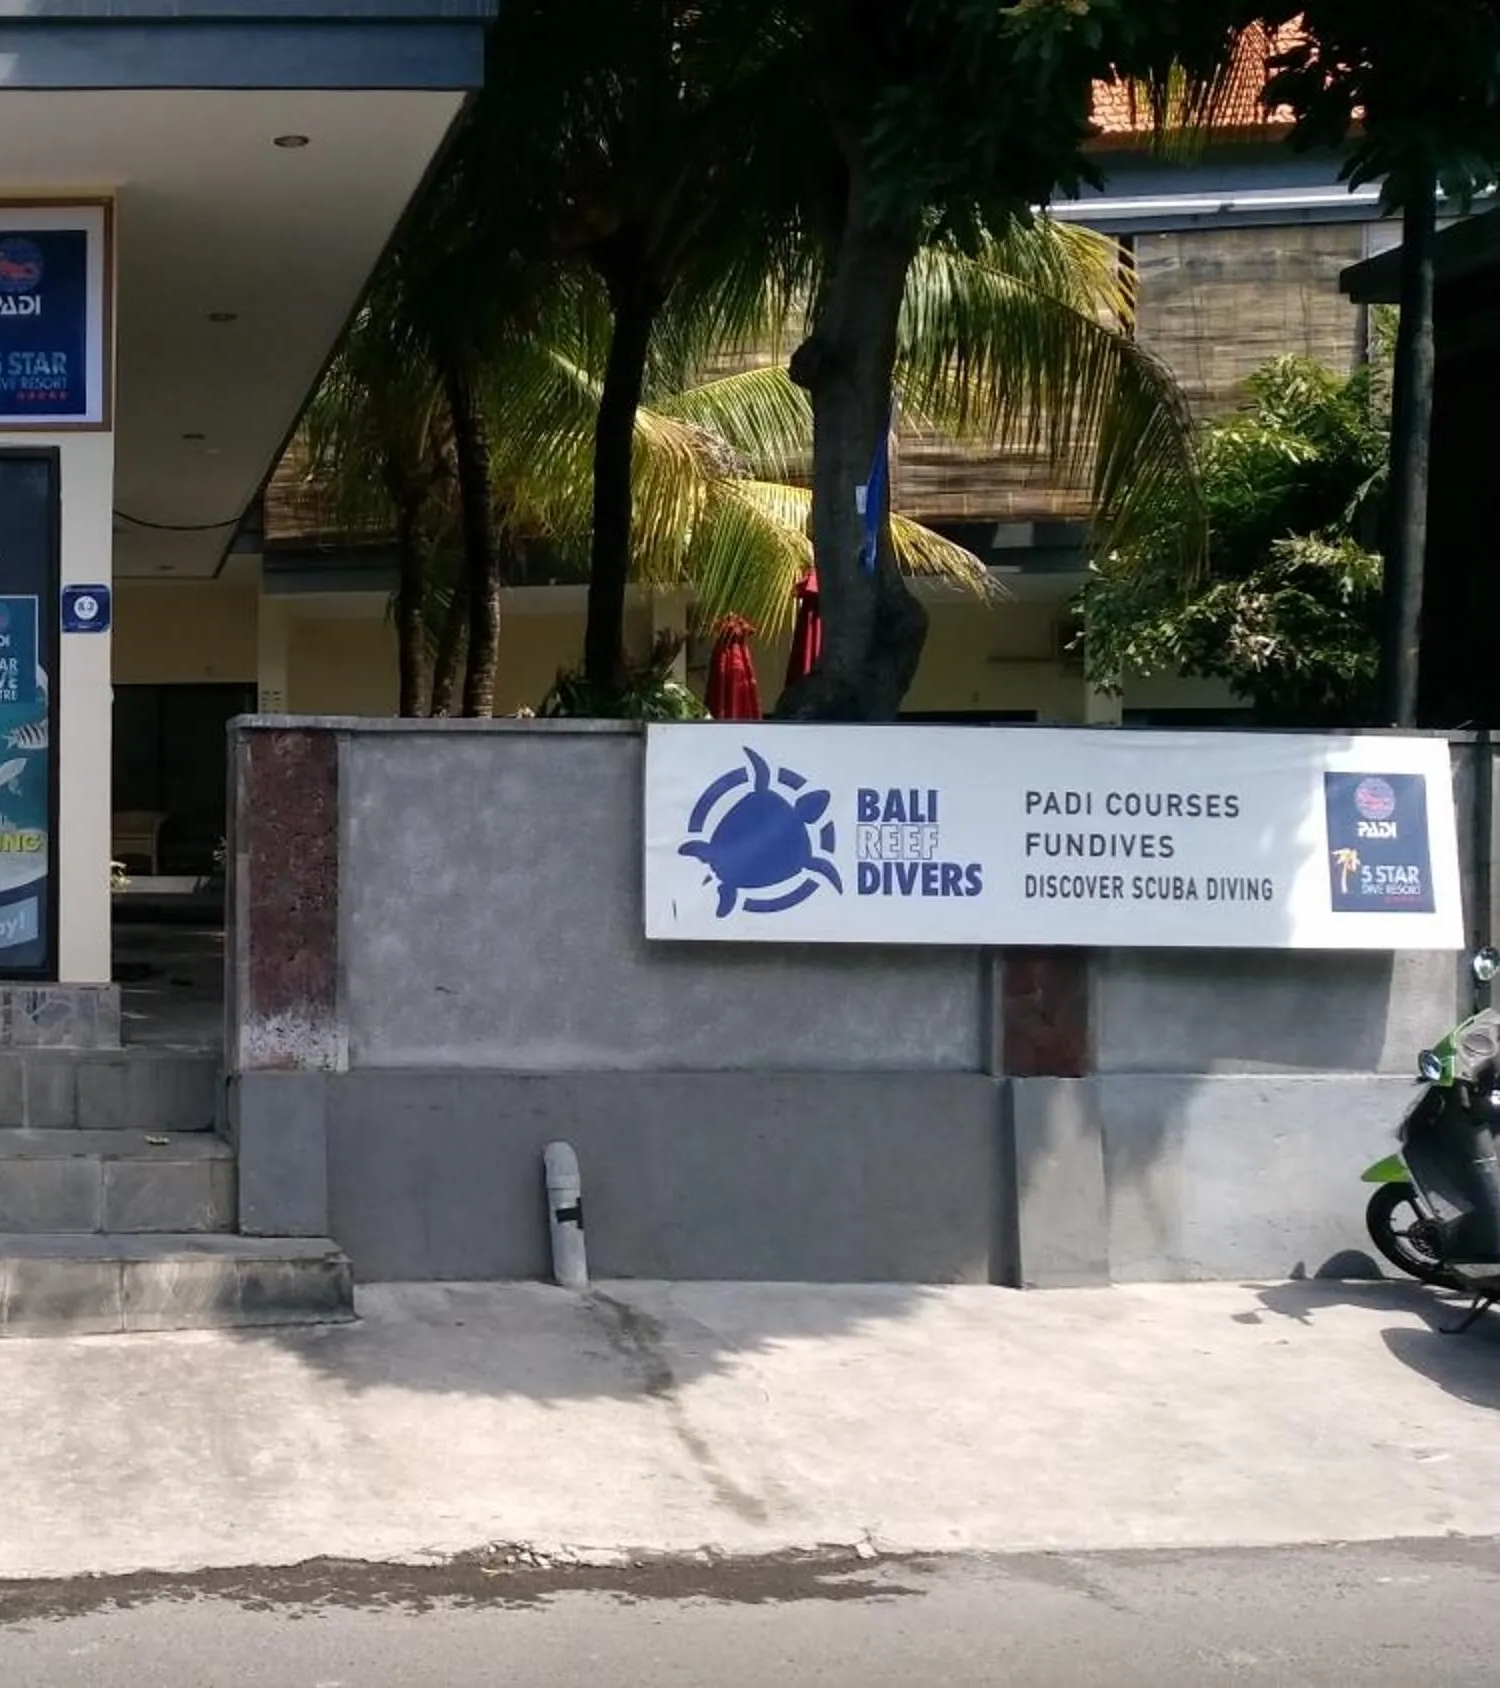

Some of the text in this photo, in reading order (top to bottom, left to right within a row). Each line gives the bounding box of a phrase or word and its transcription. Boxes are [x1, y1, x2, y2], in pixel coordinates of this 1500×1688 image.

[8, 352, 68, 375] STAR
[857, 788, 939, 823] BALI
[1025, 791, 1241, 820] PADI COURSES
[856, 825, 940, 860] REEF
[1356, 822, 1398, 839] PADI
[1025, 832, 1176, 859] FUNDIVES
[856, 863, 984, 897] DIVERS
[1025, 874, 1274, 902] DISCOVER SCUBA DIVING
[1361, 866, 1420, 884] 5 STAR
